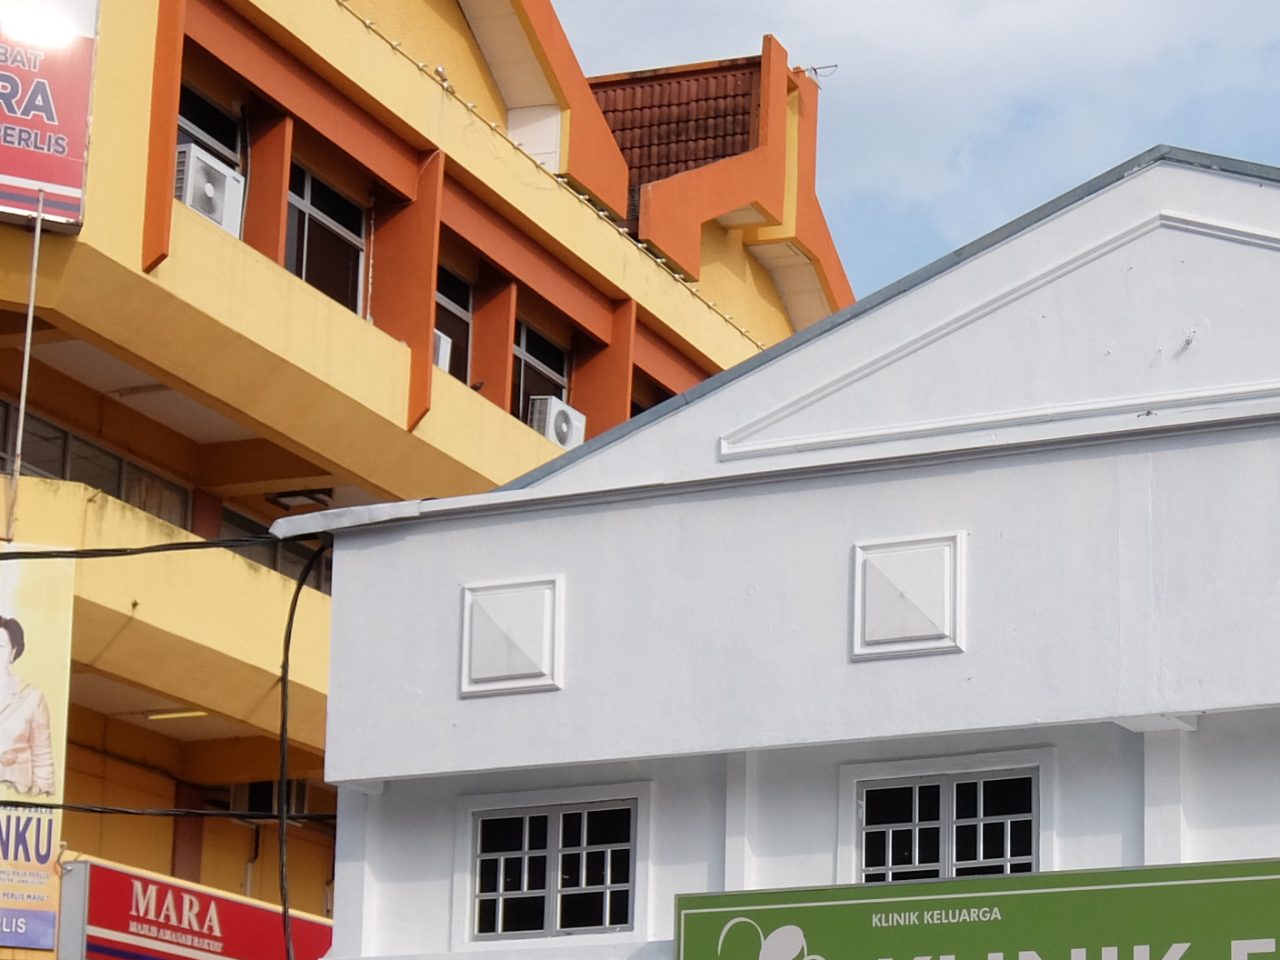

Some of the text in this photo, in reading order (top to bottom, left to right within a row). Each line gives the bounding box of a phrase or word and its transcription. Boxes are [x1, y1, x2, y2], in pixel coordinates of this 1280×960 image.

[0, 125, 68, 155] ERLIS
[129, 879, 222, 937] MARA
[872, 906, 1002, 927] KLINIK KELUARGA
[0, 917, 27, 933] LIS
